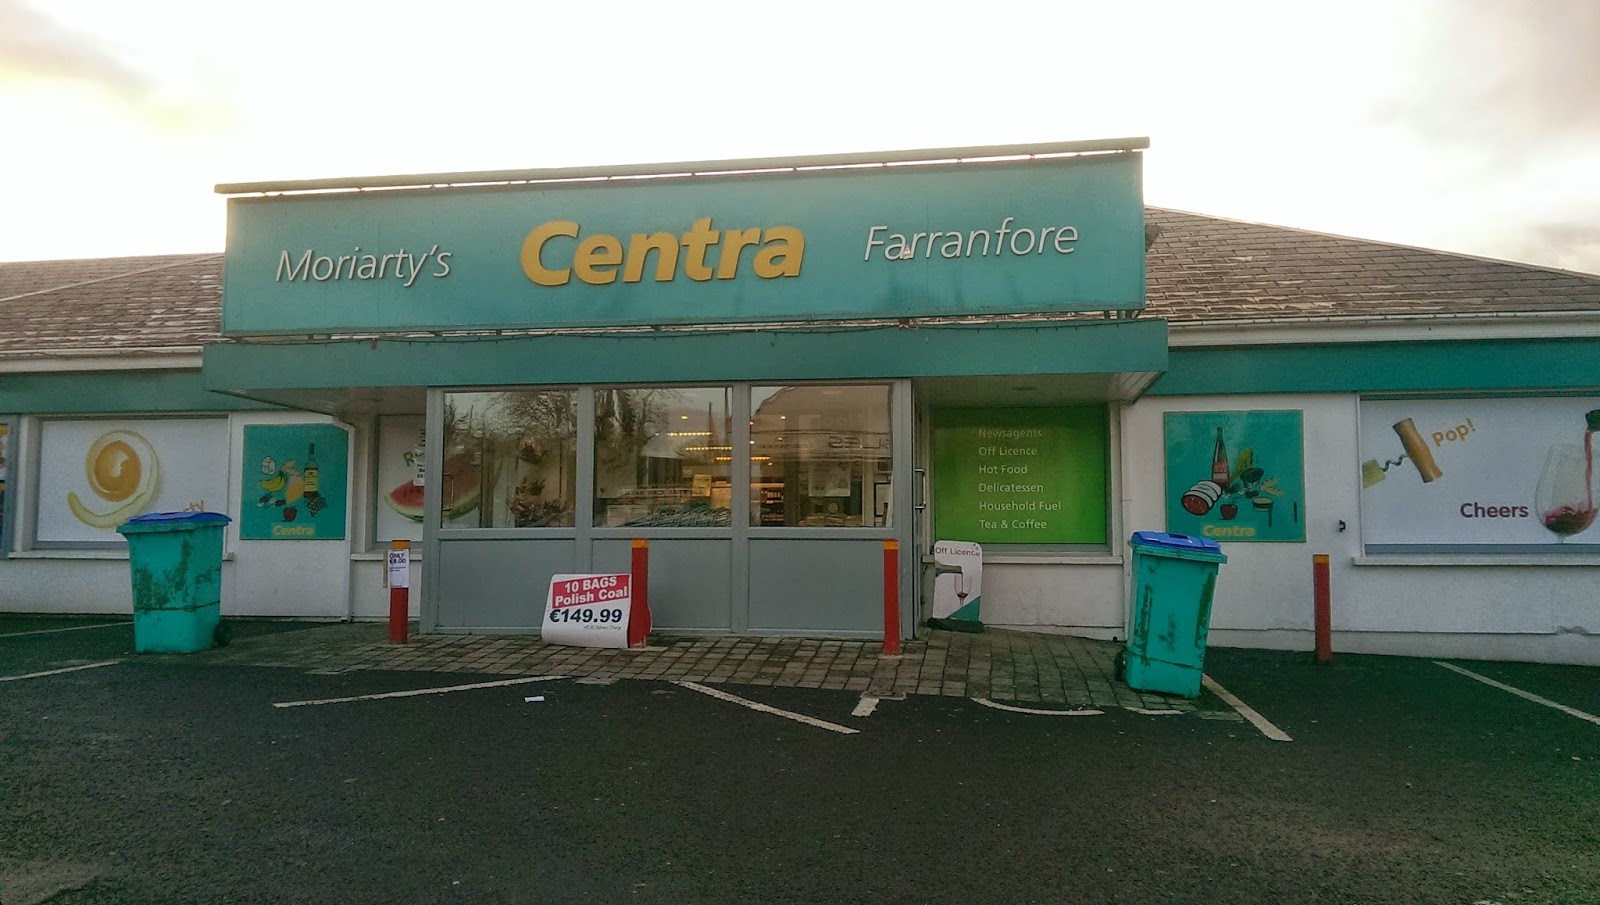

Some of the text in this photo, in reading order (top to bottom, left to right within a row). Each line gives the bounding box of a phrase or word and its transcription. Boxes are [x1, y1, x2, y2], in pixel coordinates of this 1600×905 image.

[864, 216, 1079, 262] Farranfore
[520, 217, 804, 287] Centra
[275, 245, 452, 288] Moriarty's
[978, 428, 1042, 440] Newsagents
[1432, 418, 1476, 448] Pop!
[978, 446, 1038, 456] Off Licence
[978, 465, 1028, 474] Hot Food
[978, 483, 1044, 493] Delicatessen
[978, 501, 1062, 511] Household Fuel
[1460, 502, 1529, 519] Cheers
[273, 525, 315, 536] Centra
[979, 520, 1047, 529] Tea & Coffee
[1203, 525, 1255, 537] Centra
[950, 548, 981, 556] Licence
[565, 577, 617, 593] 10 BAGS
[555, 586, 628, 606] Polish Coal
[549, 608, 622, 623] €149.99
